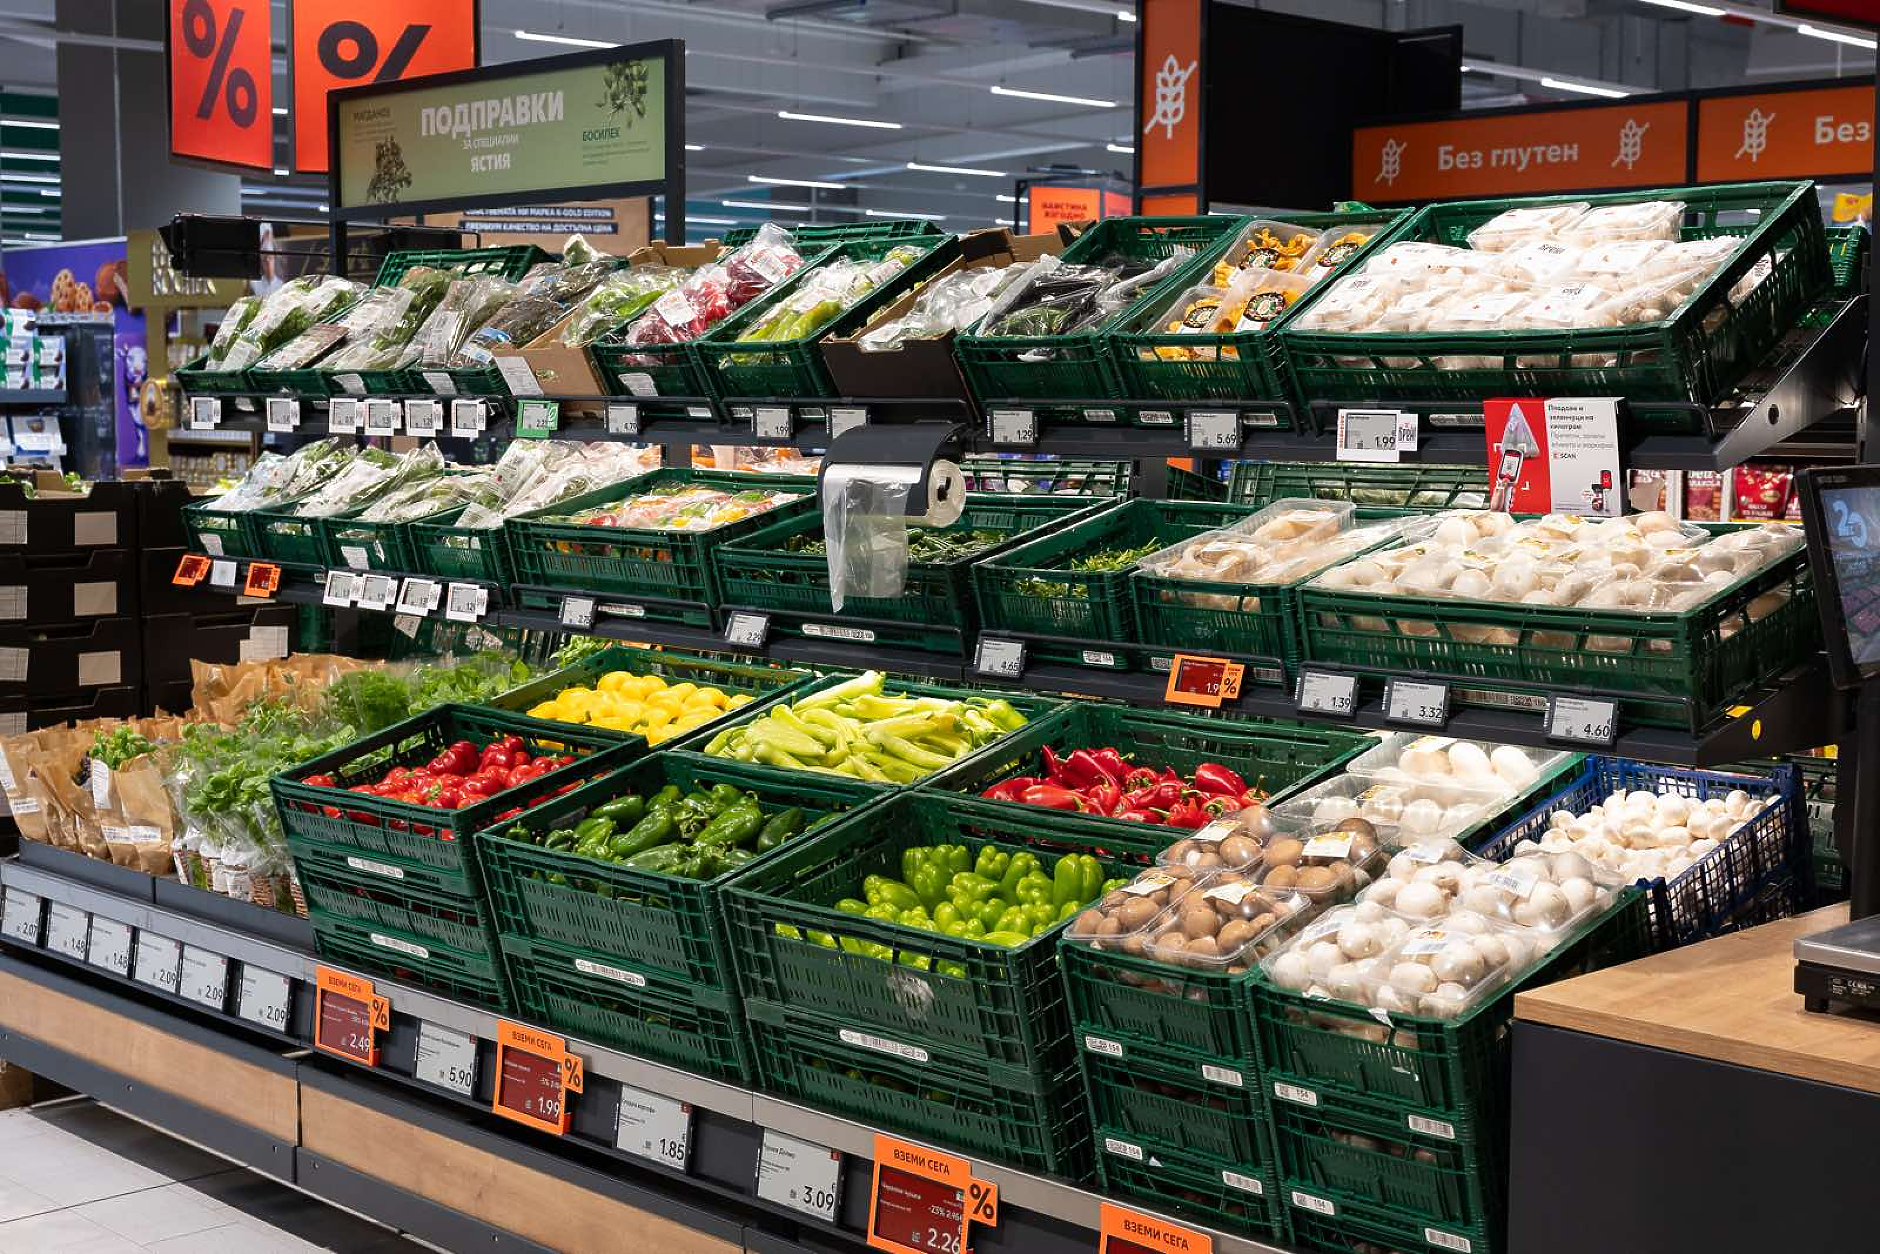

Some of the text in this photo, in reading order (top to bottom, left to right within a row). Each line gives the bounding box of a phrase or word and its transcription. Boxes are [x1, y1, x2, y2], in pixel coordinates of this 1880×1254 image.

[421, 91, 564, 139] ПОДПРАВКИ
[1814, 115, 1871, 144] Без
[470, 153, 511, 172] ЯСТИЯ
[1437, 142, 1579, 173] Без глутен
[1216, 433, 1236, 445] 5.69
[1374, 436, 1396, 450] 1.99
[1332, 696, 1351, 708] 1.39
[1418, 705, 1442, 719] 3.32
[1583, 723, 1610, 738] 4.60
[267, 1005, 285, 1023] 2.09
[349, 1033, 371, 1053] 2.49
[448, 1067, 472, 1088] 5.90
[538, 1096, 560, 1117] 1.99
[659, 1138, 685, 1161] 1.85
[893, 1148, 950, 1177] ВЗЕМИ СЕГА
[803, 1185, 834, 1212] 3.09
[927, 1227, 961, 1254] 2.26
[1123, 1219, 1189, 1252] ВЗЕМИ СЕГА
